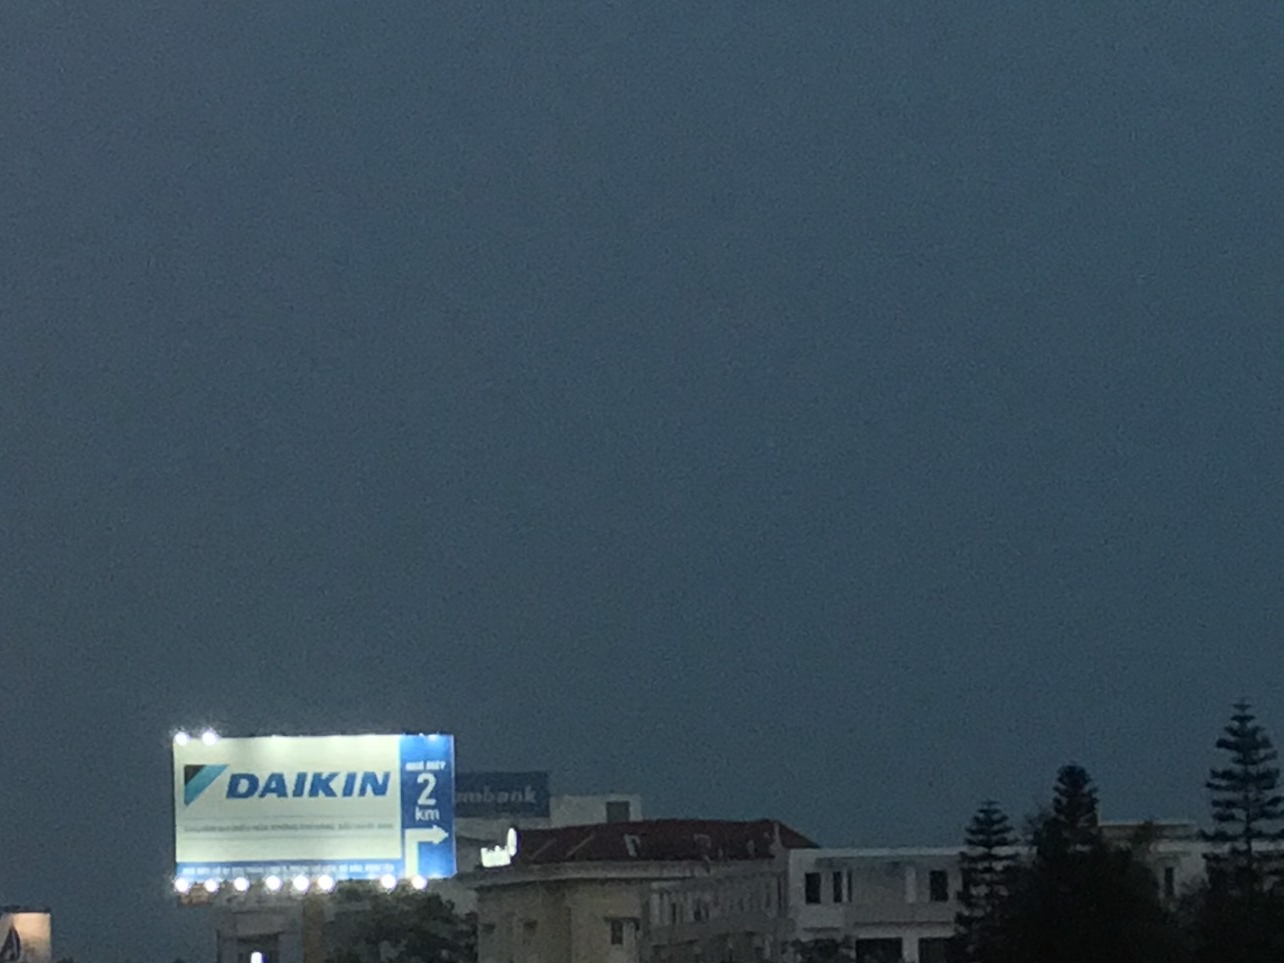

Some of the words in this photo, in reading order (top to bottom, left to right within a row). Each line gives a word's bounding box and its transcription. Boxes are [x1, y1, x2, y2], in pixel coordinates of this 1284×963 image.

[226, 772, 391, 798] DAIKIN
[417, 772, 437, 806] 2
[415, 806, 440, 821] km
